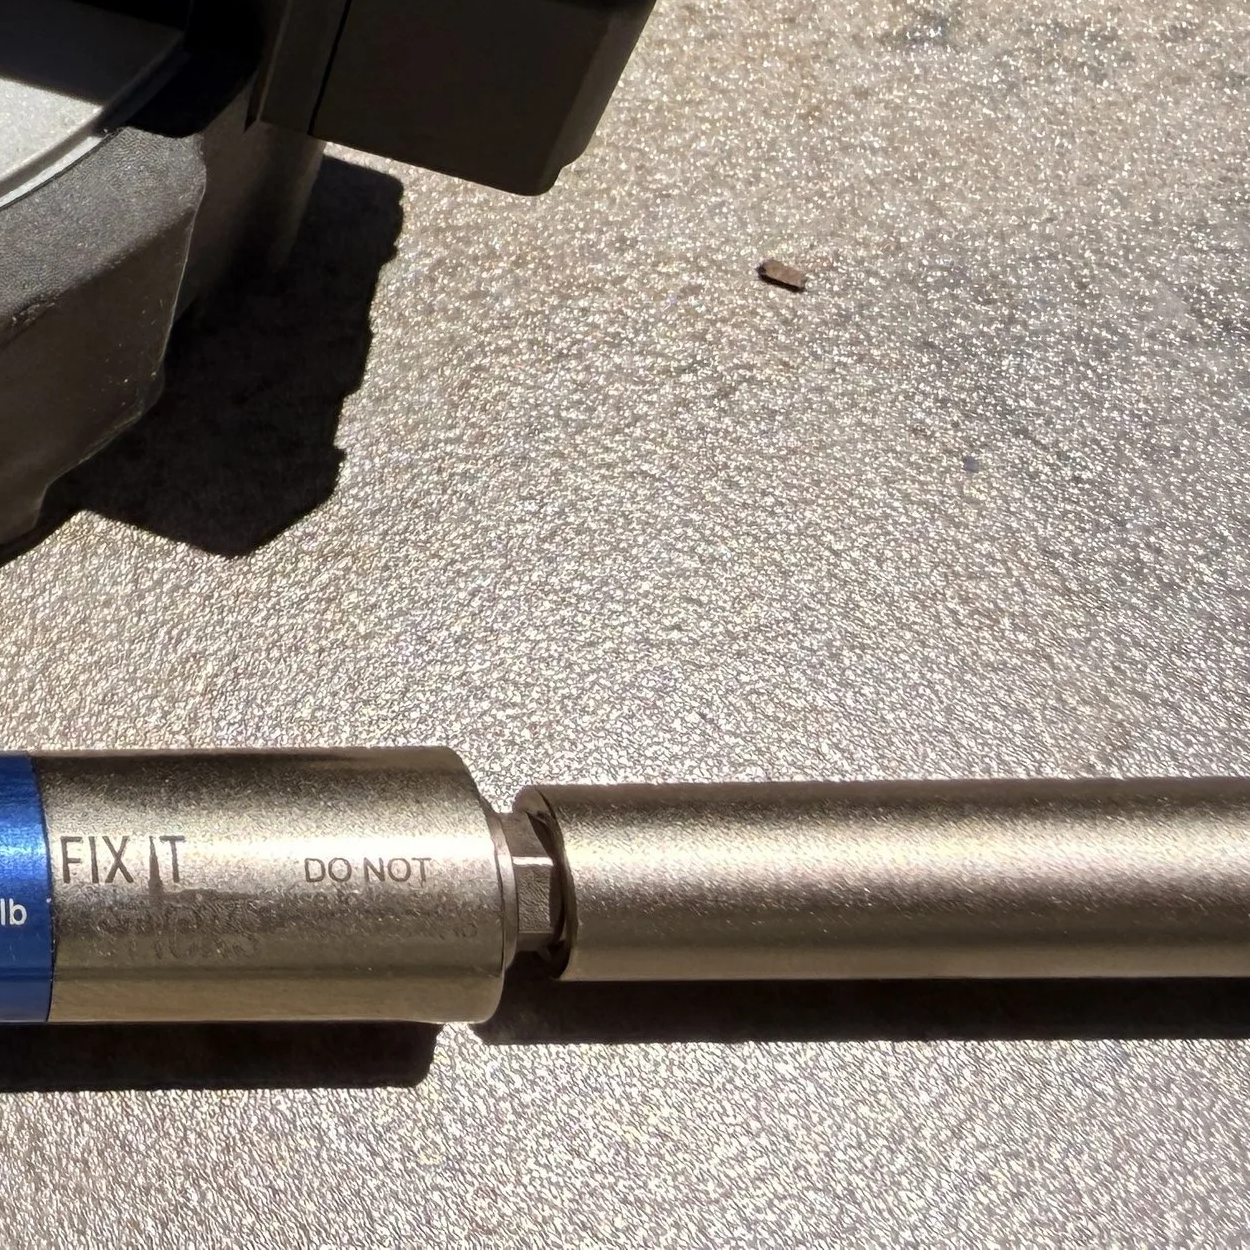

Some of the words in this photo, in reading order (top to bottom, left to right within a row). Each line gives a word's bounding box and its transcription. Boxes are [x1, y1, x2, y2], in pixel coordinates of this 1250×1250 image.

[60, 835, 134, 884] FIX
[303, 856, 352, 884] DO
[362, 856, 433, 885] NOT
